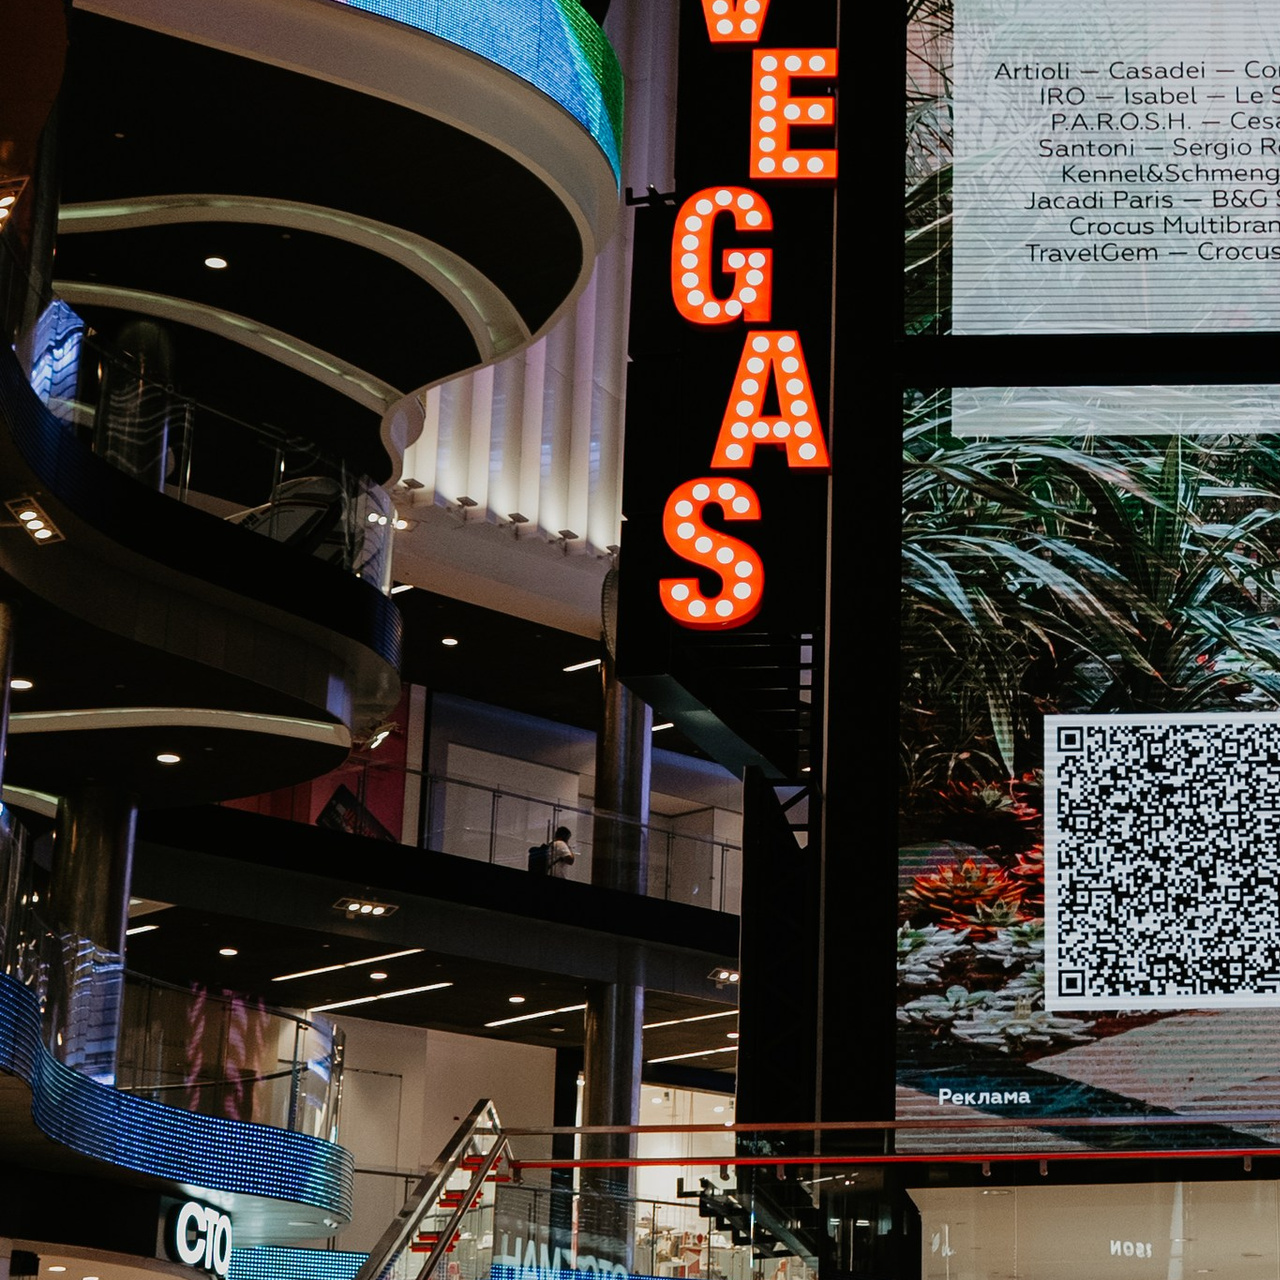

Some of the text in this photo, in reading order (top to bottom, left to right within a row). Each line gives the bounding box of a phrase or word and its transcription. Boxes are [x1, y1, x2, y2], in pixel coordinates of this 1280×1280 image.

[994, 60, 1071, 81] Artioli
[1107, 59, 1206, 81] Casadei
[1039, 86, 1086, 106] IRO
[1123, 84, 1198, 105] Isabel
[1234, 85, 1265, 105] Le
[1050, 111, 1192, 132] P.A.R.O.S.H.
[1038, 136, 1136, 159] Santoni
[1172, 136, 1252, 161] Sergio
[1023, 188, 1105, 211] Jacadi
[1112, 188, 1174, 210] Paris
[1211, 188, 1269, 209] B&G
[1068, 215, 1155, 236] Crocus
[1025, 241, 1160, 262] TravelGem
[938, 1086, 1032, 1106] Реклама
